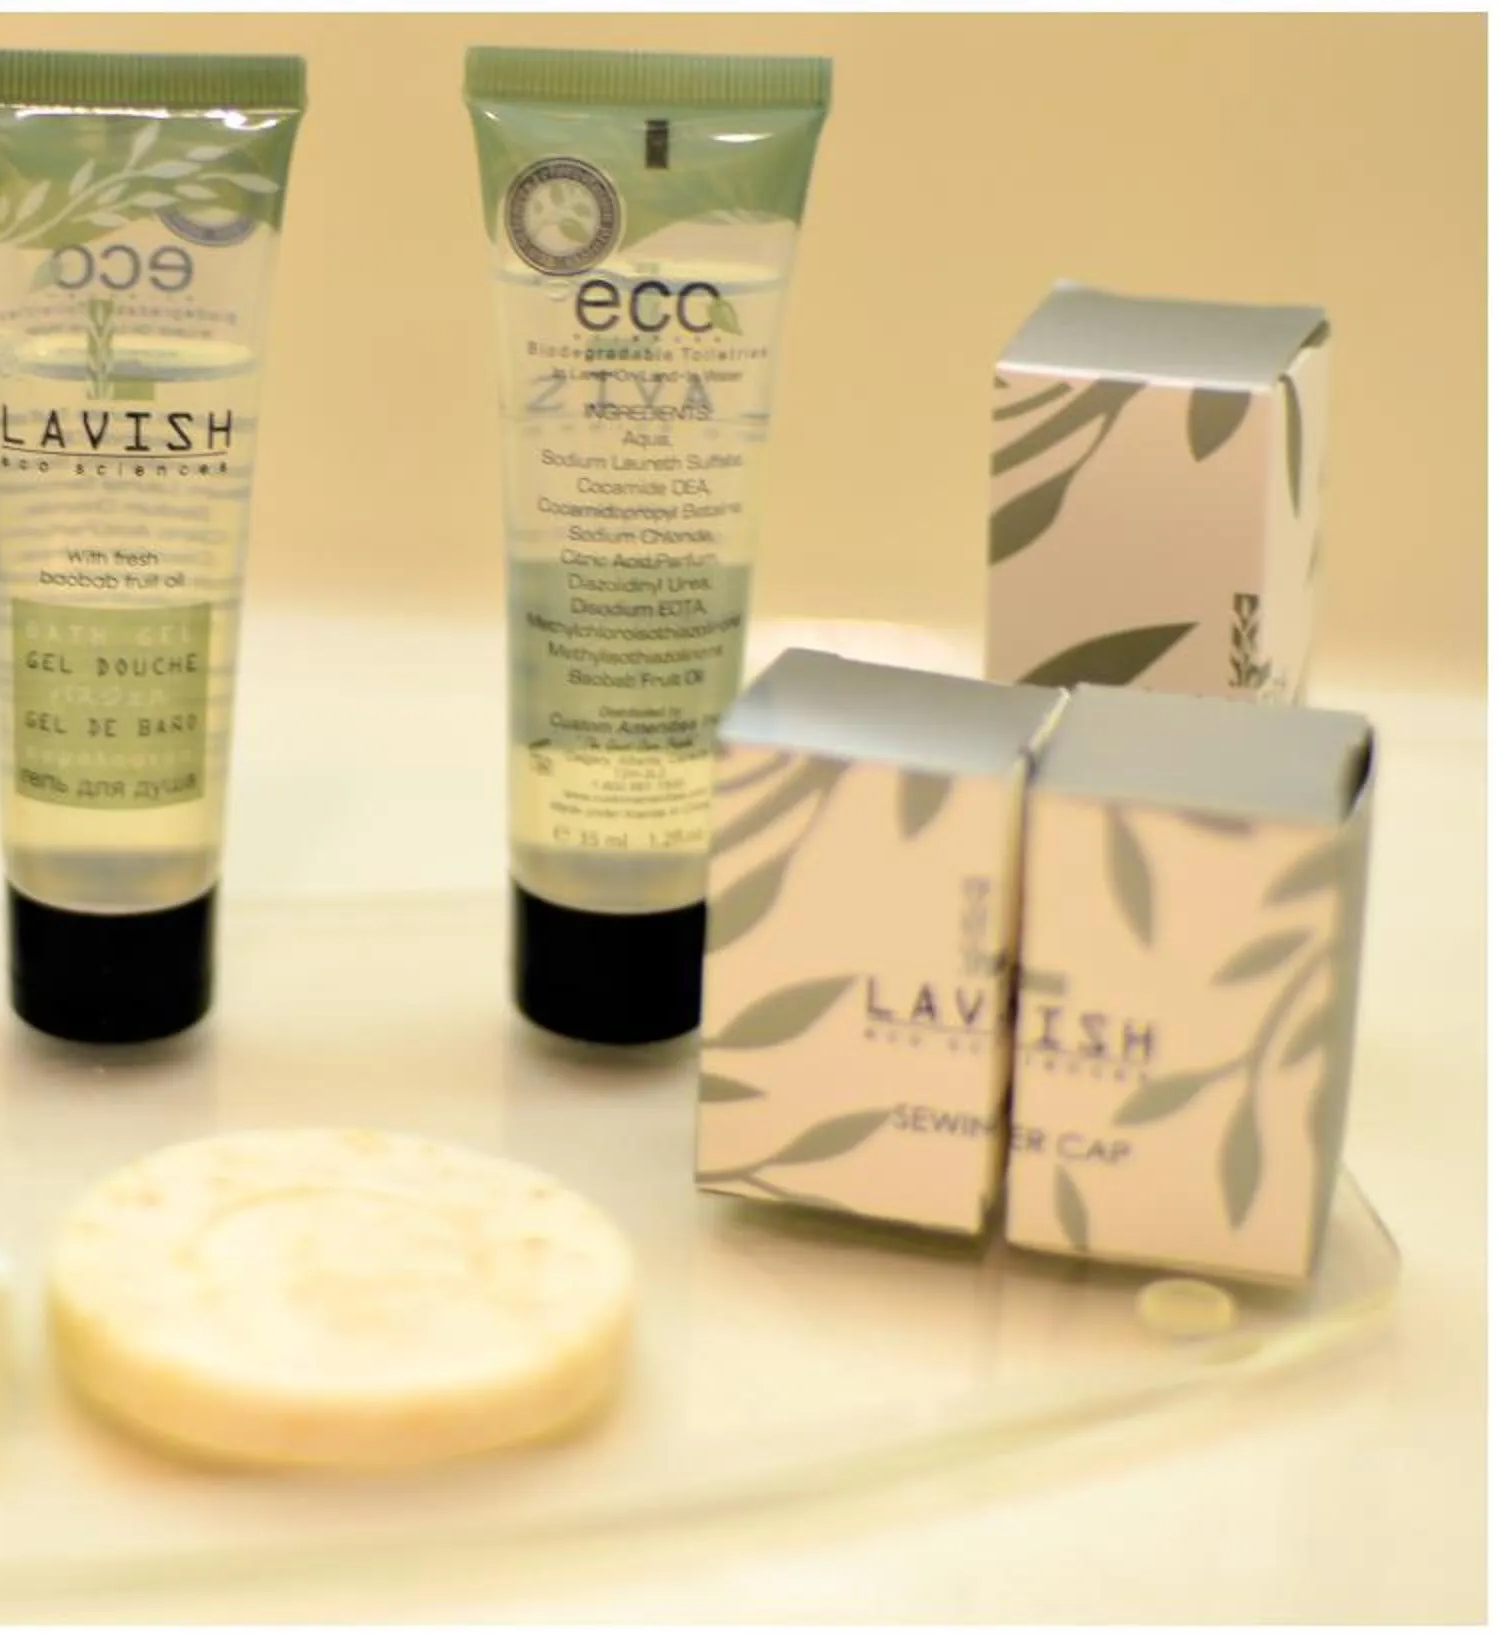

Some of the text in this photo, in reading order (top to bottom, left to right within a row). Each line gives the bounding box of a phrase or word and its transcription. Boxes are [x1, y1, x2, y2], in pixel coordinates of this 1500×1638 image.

[2, 404, 233, 451] LAVISH
[1, 455, 49, 473] eco
[66, 549, 160, 567] With fresh
[39, 570, 119, 589] baobab
[123, 572, 161, 588] fruit
[25, 650, 200, 678] GEL DOUCHE
[23, 710, 69, 735] GEL
[86, 717, 118, 738] DE
